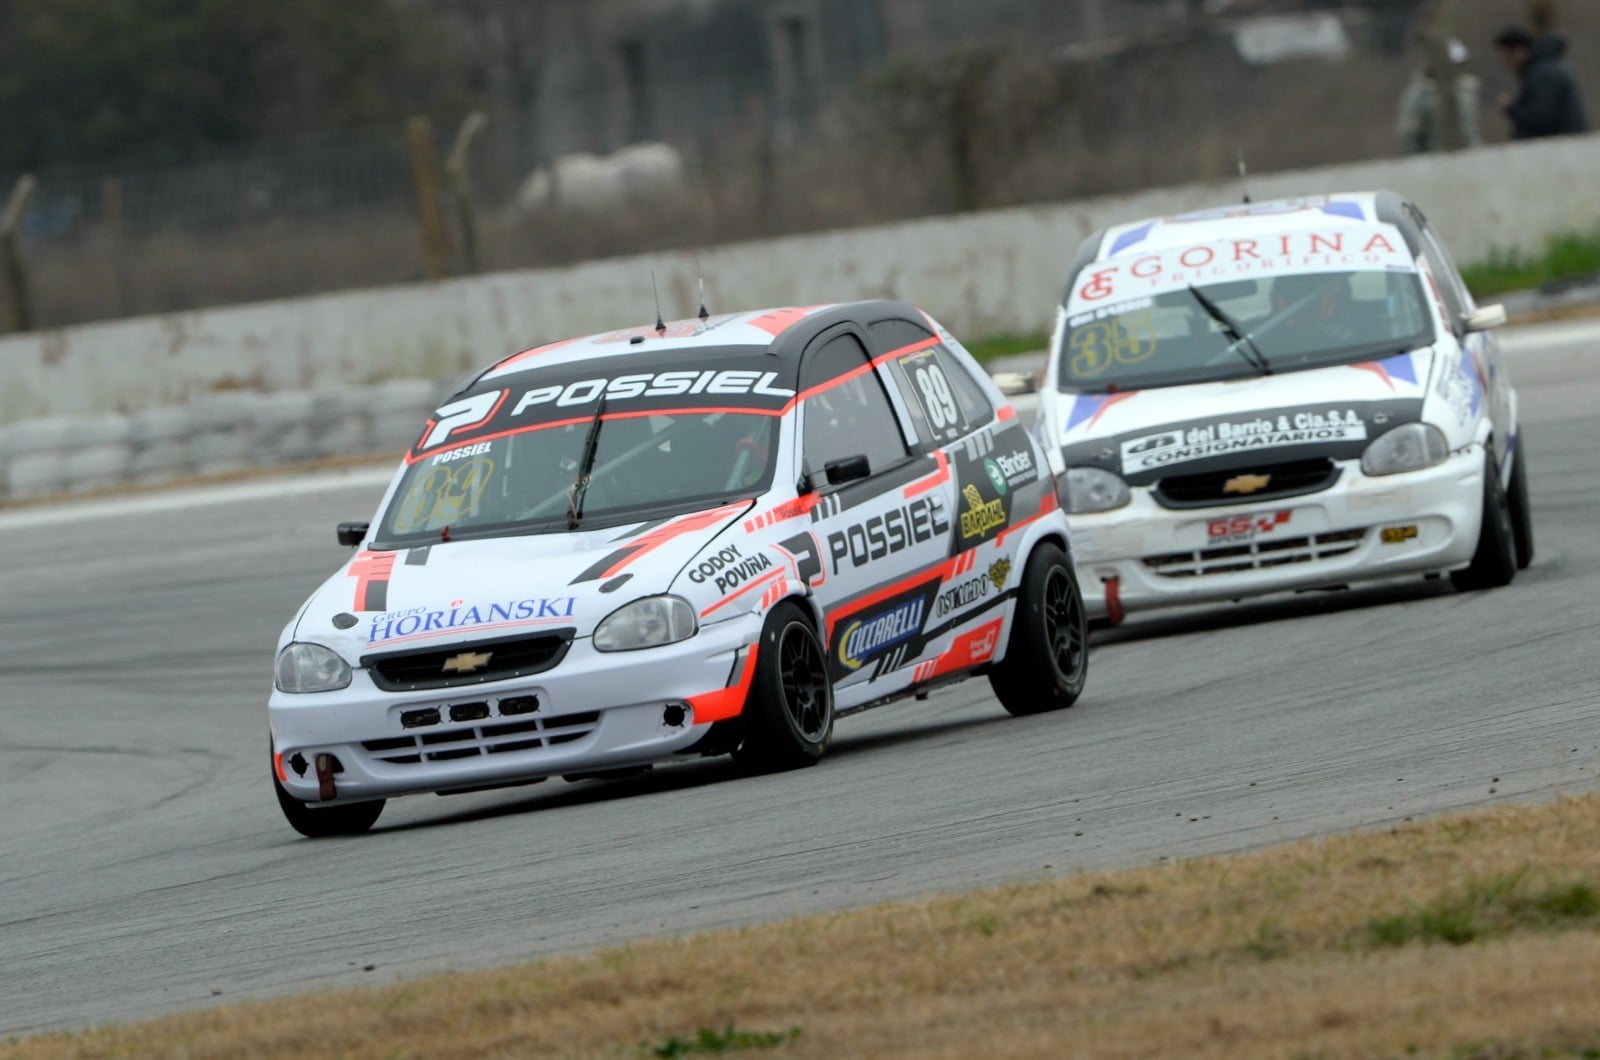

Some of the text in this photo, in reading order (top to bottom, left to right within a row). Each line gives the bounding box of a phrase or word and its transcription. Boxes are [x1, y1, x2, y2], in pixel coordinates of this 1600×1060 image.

[1130, 232, 1396, 278] GORINA
[1071, 309, 1157, 378] 35
[510, 370, 797, 417] POSSIEL
[916, 364, 957, 429] 89
[1141, 428, 1346, 467] CONSIGNATARIOS
[1186, 425, 1214, 445] del
[1218, 417, 1274, 439] Barrio
[1277, 415, 1291, 431] &
[432, 442, 493, 466] POSSIEL
[395, 458, 495, 530] 89
[827, 496, 949, 576] POSSIEL
[962, 500, 1005, 538] BARDAHL
[688, 543, 742, 584] GODOY
[714, 552, 773, 595] POVIÑA
[368, 597, 578, 643] HORIANSKI
[372, 606, 427, 623] GRUPO
[846, 599, 926, 660] CICCARELLI
